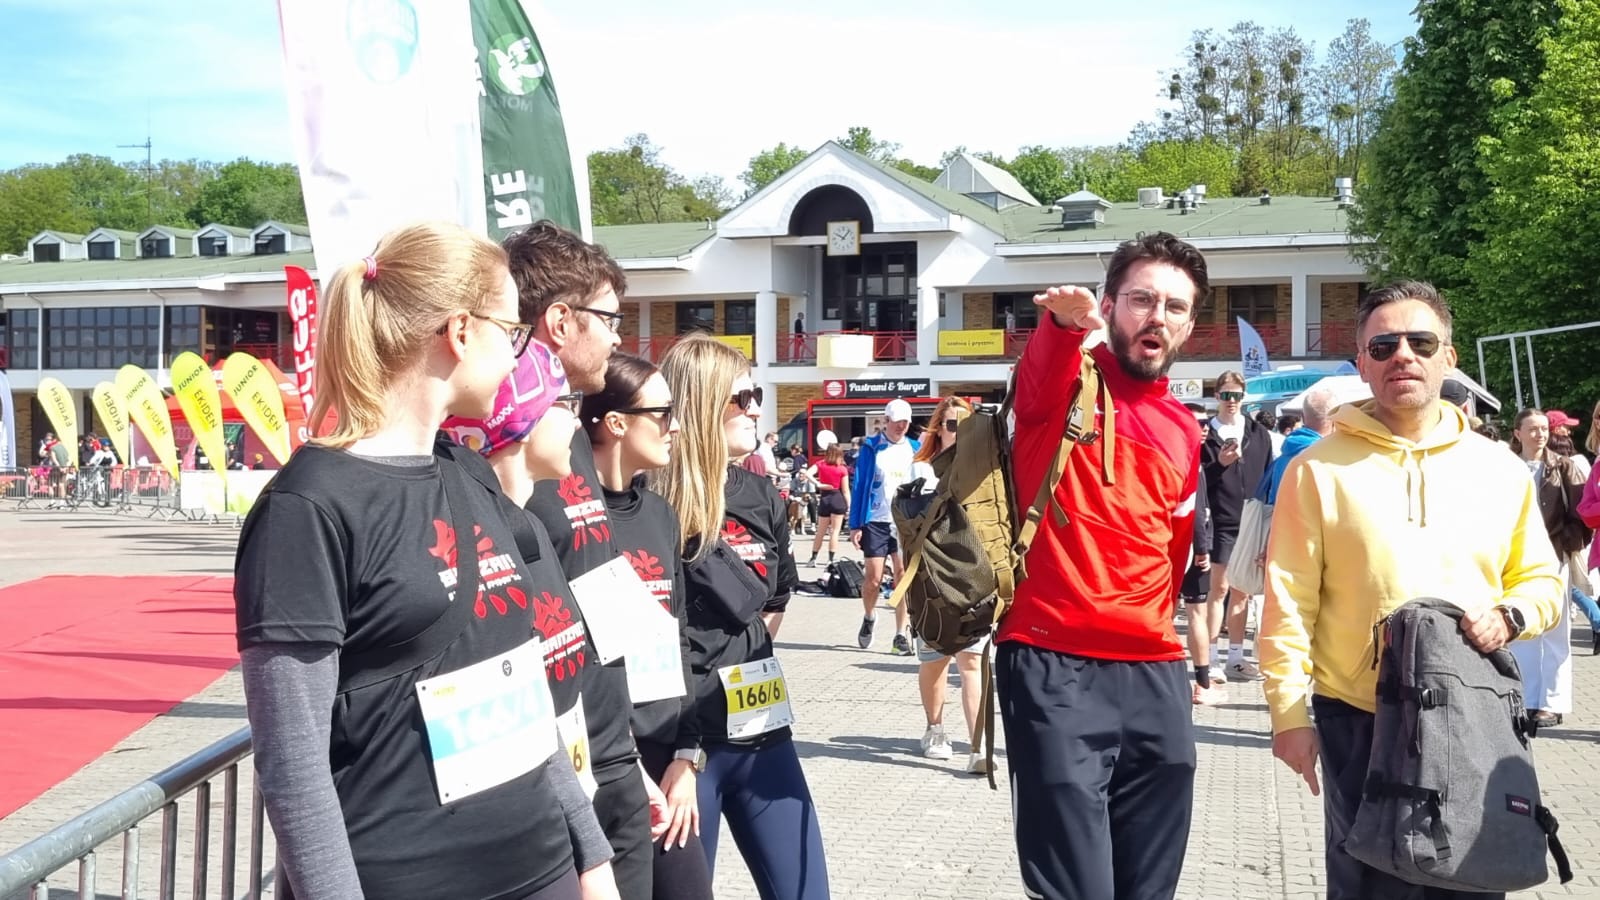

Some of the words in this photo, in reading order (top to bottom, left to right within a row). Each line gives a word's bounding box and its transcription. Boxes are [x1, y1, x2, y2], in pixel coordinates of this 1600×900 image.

[490, 170, 533, 234] RE
[178, 365, 204, 391] JUNIOR
[233, 365, 258, 397] JUNIOR
[849, 382, 887, 392] Pastrami
[888, 382, 896, 391] &
[897, 382, 927, 393] Burger
[193, 390, 218, 429] EKIDEN
[252, 391, 282, 431] EKIDEN
[735, 680, 781, 710] 166/6
